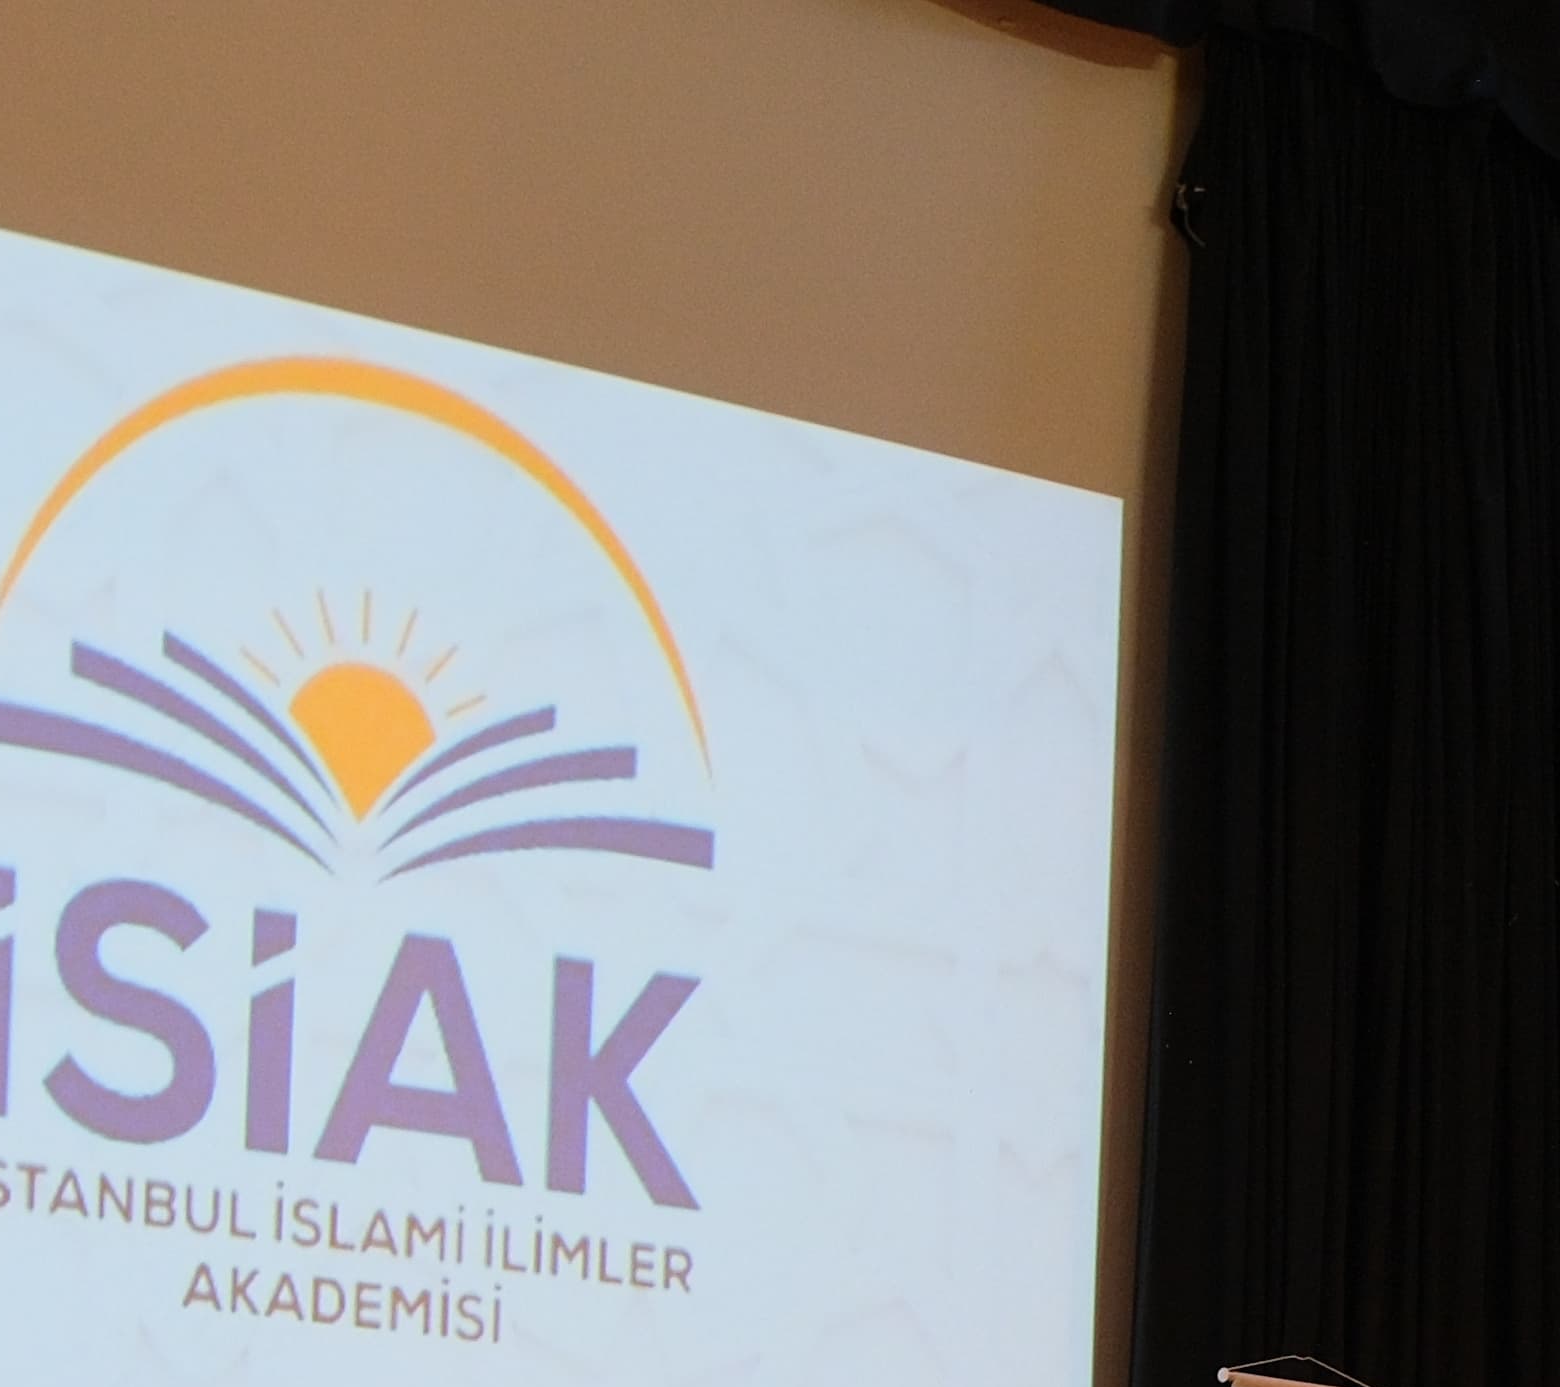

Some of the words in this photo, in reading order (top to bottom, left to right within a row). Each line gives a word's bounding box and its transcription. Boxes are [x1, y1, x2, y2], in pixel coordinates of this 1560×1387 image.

[273, 1180, 465, 1266] İSLAMİ
[483, 1208, 694, 1293] İLİMLER
[181, 1261, 503, 1344] AKADEMİSİ
